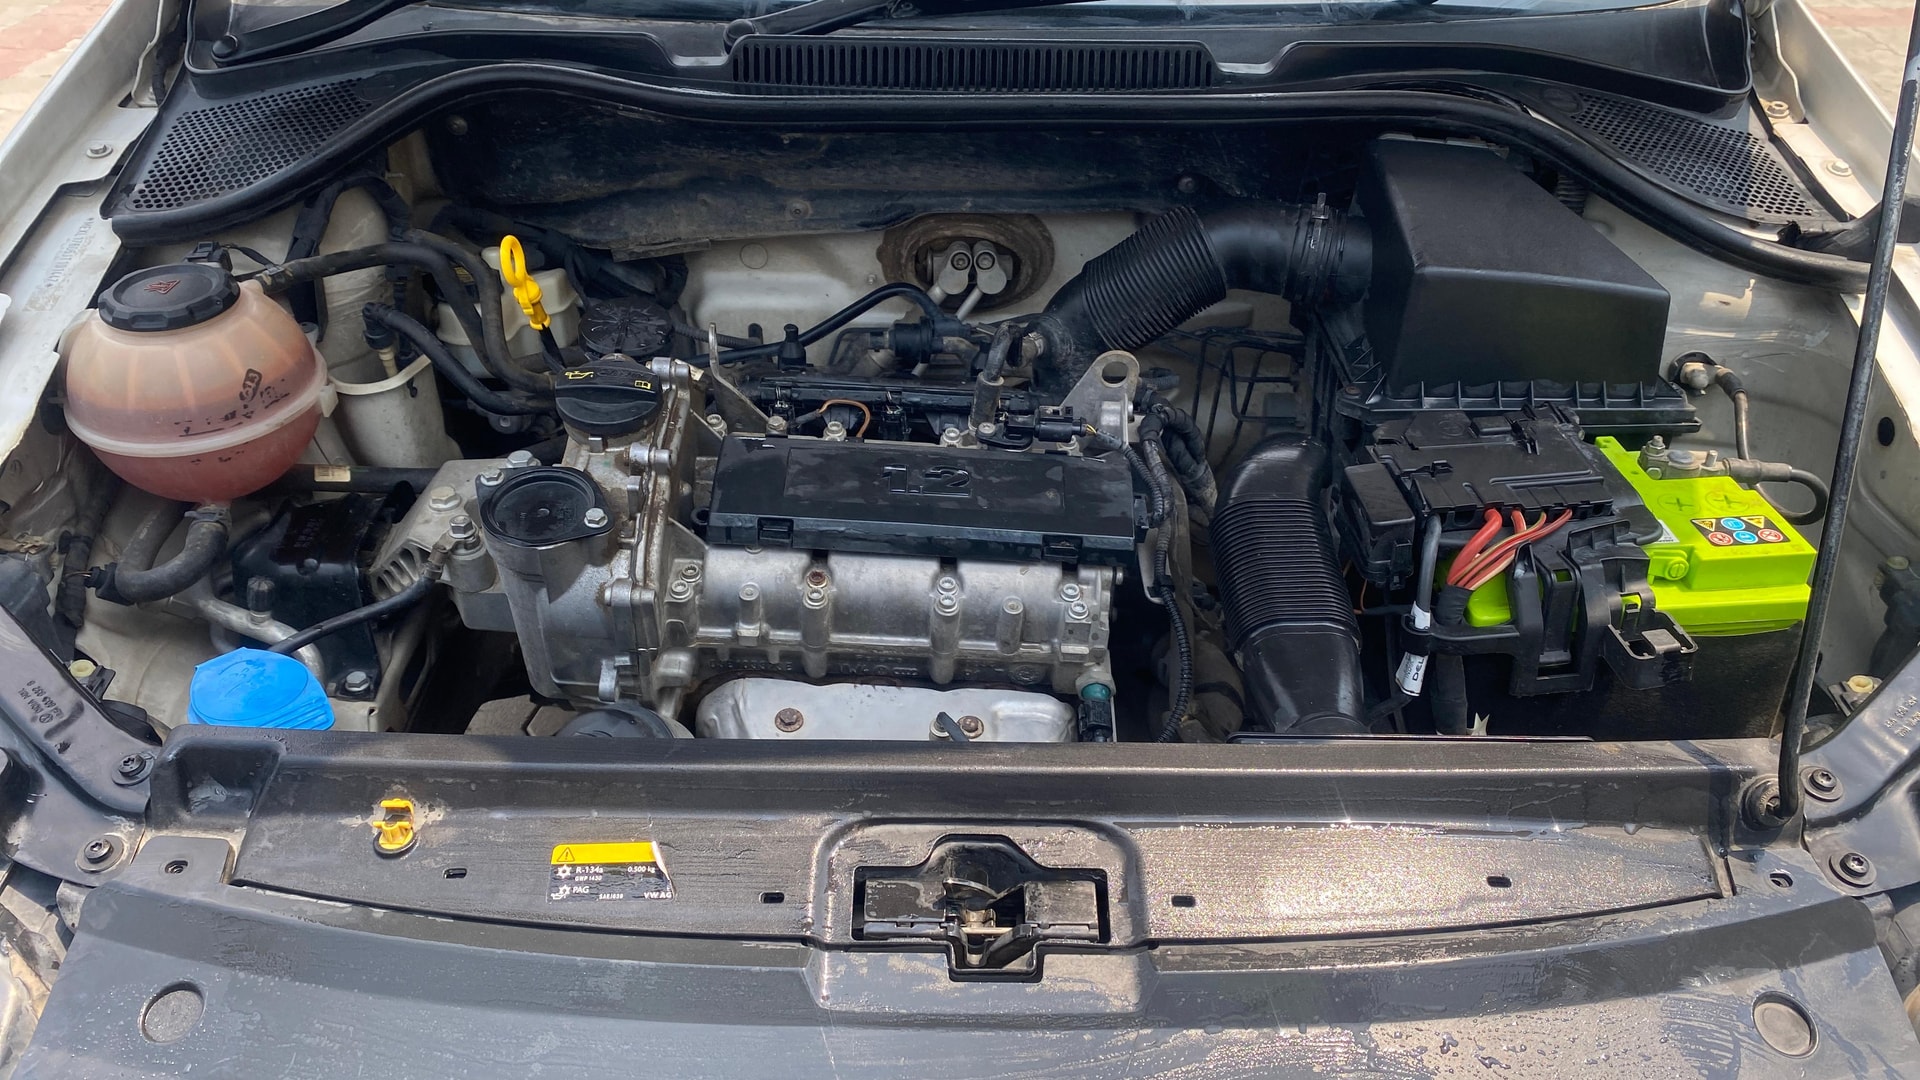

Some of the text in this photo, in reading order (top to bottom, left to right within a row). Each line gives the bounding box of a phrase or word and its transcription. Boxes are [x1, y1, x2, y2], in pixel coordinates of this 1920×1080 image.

[881, 464, 972, 497] 1.2
[575, 866, 604, 874] R-134a
[572, 885, 590, 894] PAG
